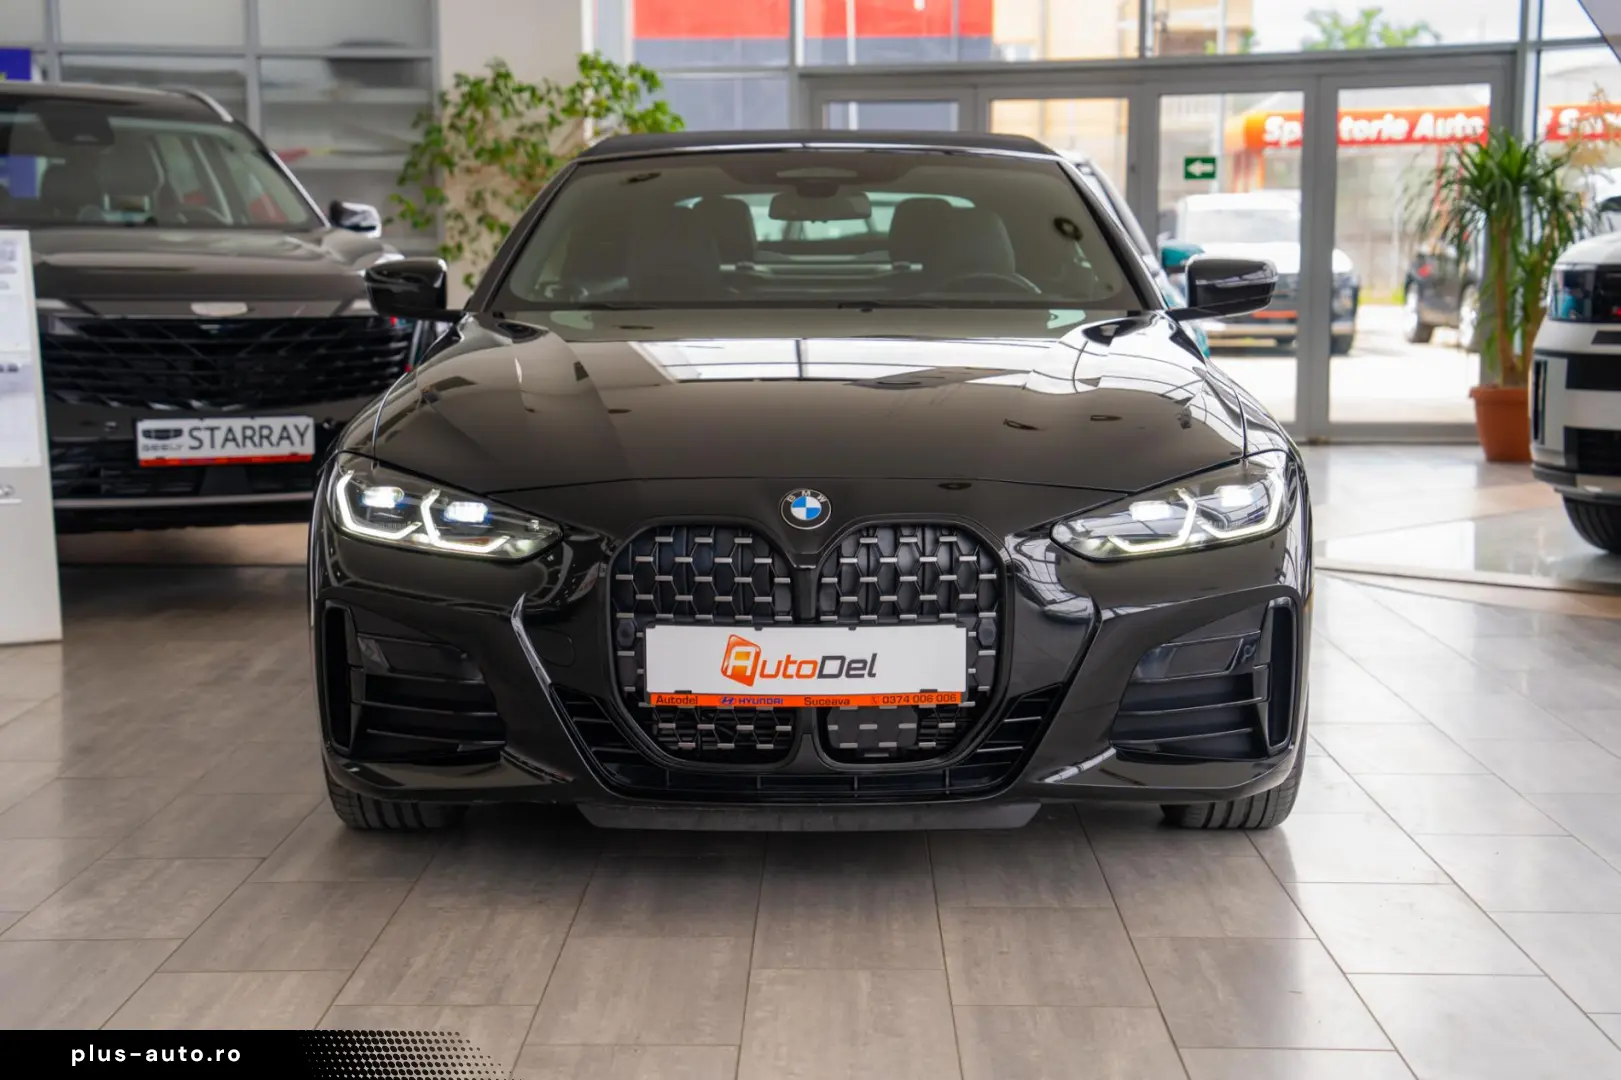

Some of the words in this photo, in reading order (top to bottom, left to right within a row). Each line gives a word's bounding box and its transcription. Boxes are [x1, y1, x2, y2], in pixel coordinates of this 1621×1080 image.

[1412, 112, 1485, 139] Auto
[188, 423, 310, 450] STARRAY
[786, 490, 828, 503] BMW
[723, 640, 878, 683] AutoDel
[656, 695, 698, 705] Autodel
[804, 696, 850, 706] Suceava
[882, 695, 910, 704] 0374
[912, 694, 934, 703] 006
[936, 694, 957, 703] 006
